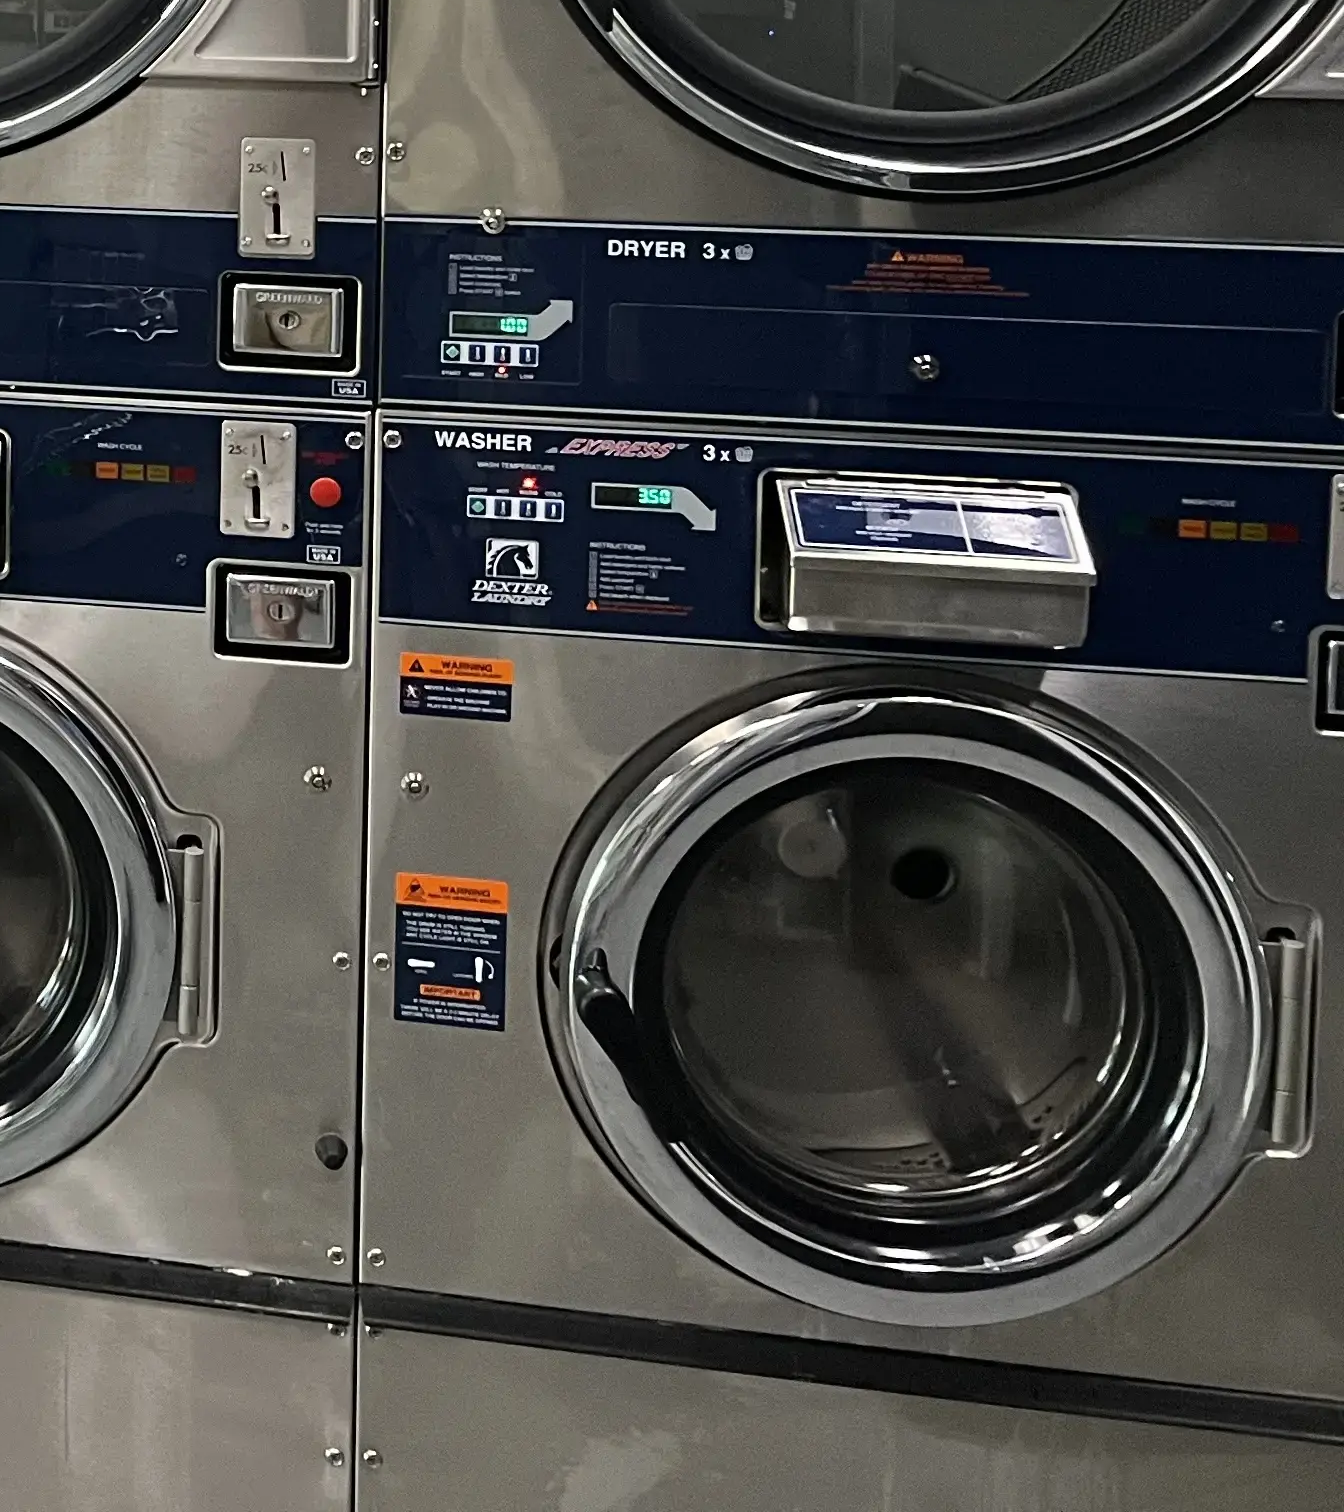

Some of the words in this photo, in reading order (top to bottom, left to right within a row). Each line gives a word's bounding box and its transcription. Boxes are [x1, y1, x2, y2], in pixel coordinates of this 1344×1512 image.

[607, 240, 686, 259] DRYER
[702, 243, 715, 259] 3
[434, 431, 532, 452] WASHER
[560, 438, 677, 459] EXPRESS
[703, 445, 716, 461] 3
[313, 553, 334, 562] USA
[472, 580, 549, 596] DEXTER
